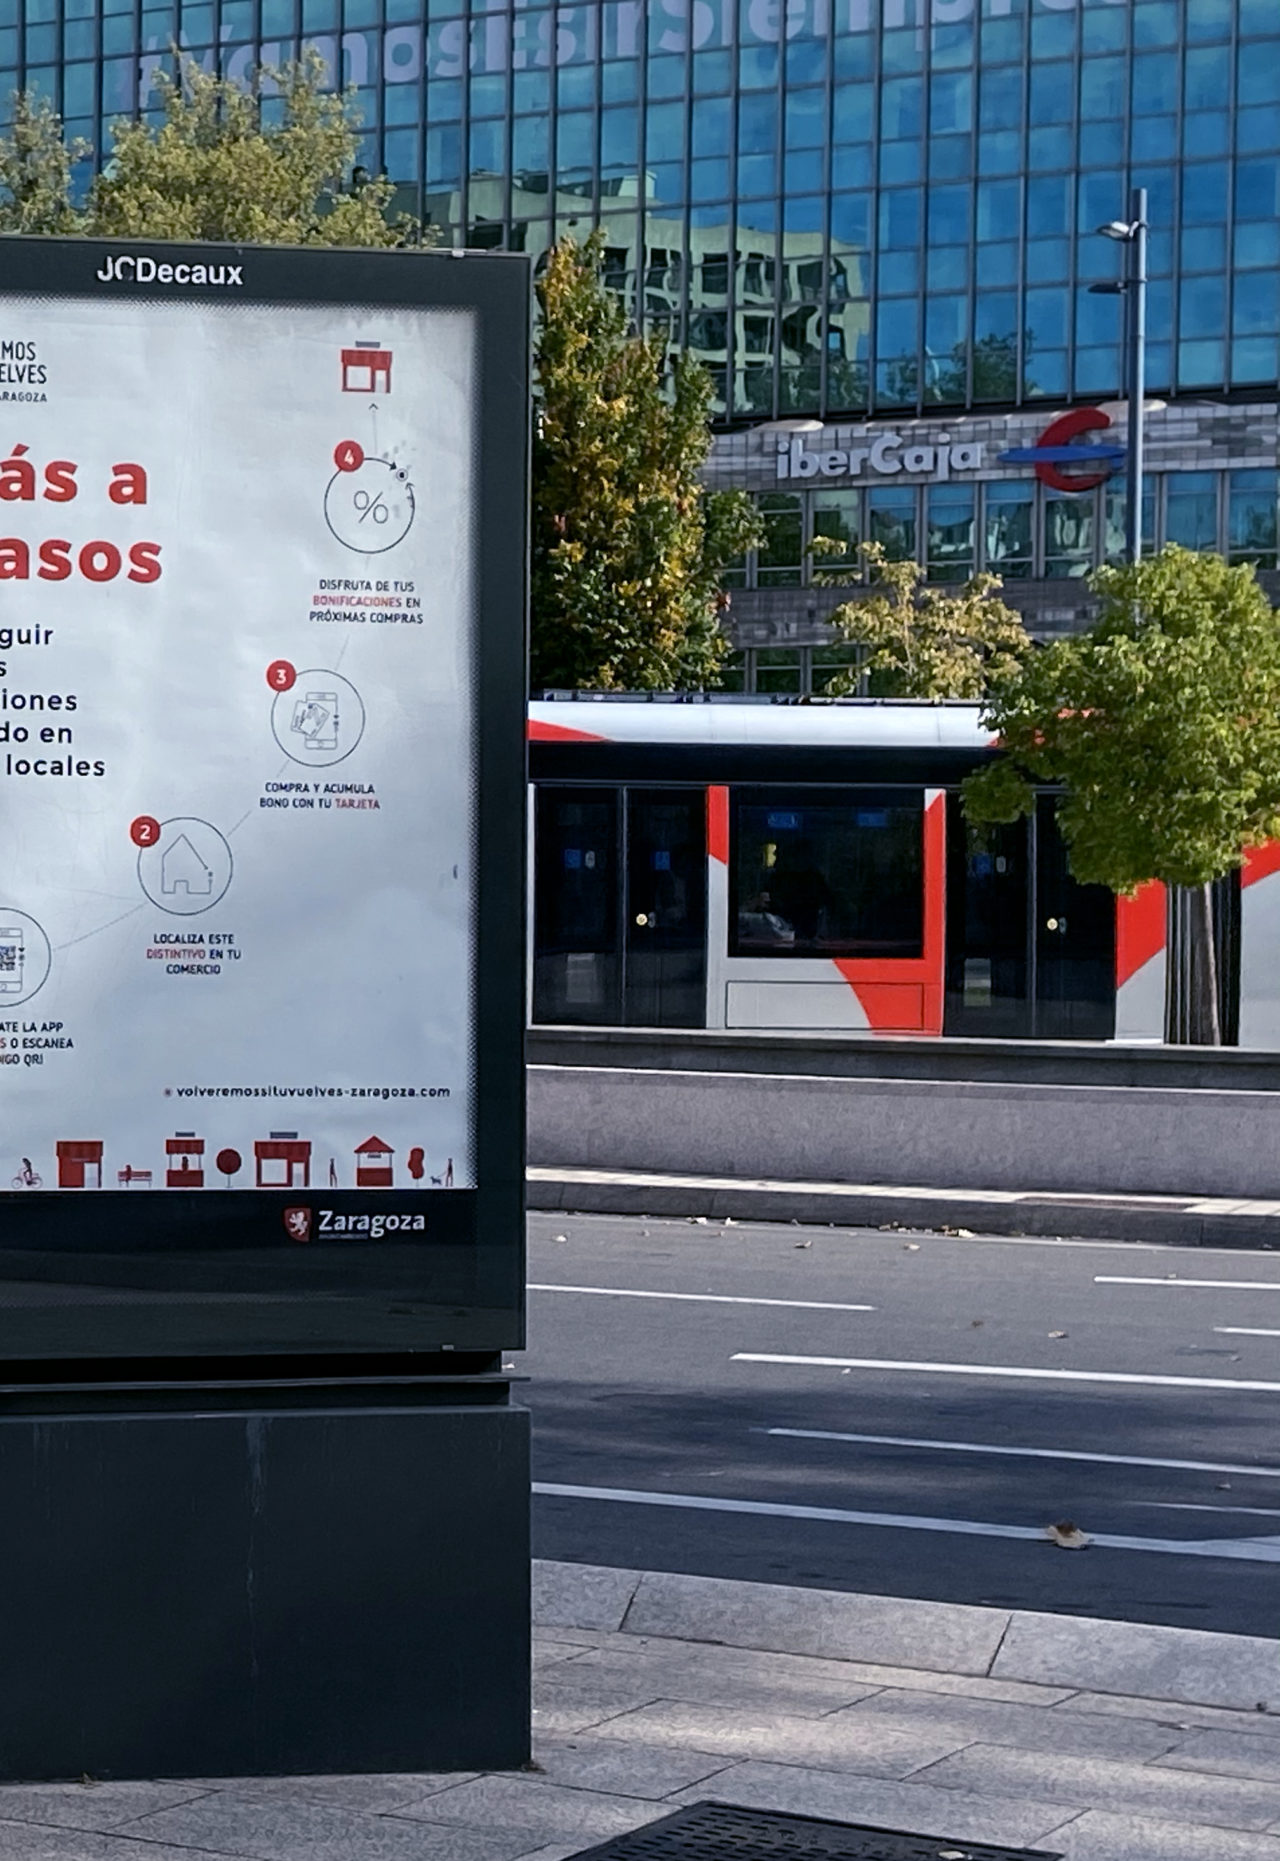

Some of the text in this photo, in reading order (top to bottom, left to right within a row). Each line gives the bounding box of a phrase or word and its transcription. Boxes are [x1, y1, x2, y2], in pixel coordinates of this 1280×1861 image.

[96, 255, 243, 286] JCDecaux
[776, 432, 983, 480] iberCaja
[108, 461, 149, 505] a
[319, 578, 415, 593] DISFRUTA DE TUS
[313, 594, 421, 609] BONIFICACIONES EN
[309, 608, 424, 625] PRÓXIMAS COMPRAS
[40, 726, 73, 744] en
[6, 754, 106, 777] locales
[265, 781, 375, 794] COMPRA Y ACUMULA
[259, 797, 381, 810] BONO CON TU TARJETA
[153, 933, 234, 946] LOCALIZA ESTE
[146, 948, 241, 960] DISTINTIVO EN TU
[165, 963, 221, 975] COMERCIO
[22, 1021, 37, 1033] LA
[40, 1021, 64, 1033] APP
[10, 1038, 18, 1049] O
[22, 1037, 74, 1049] ESCANEA
[318, 1210, 426, 1238] Zaragoza
